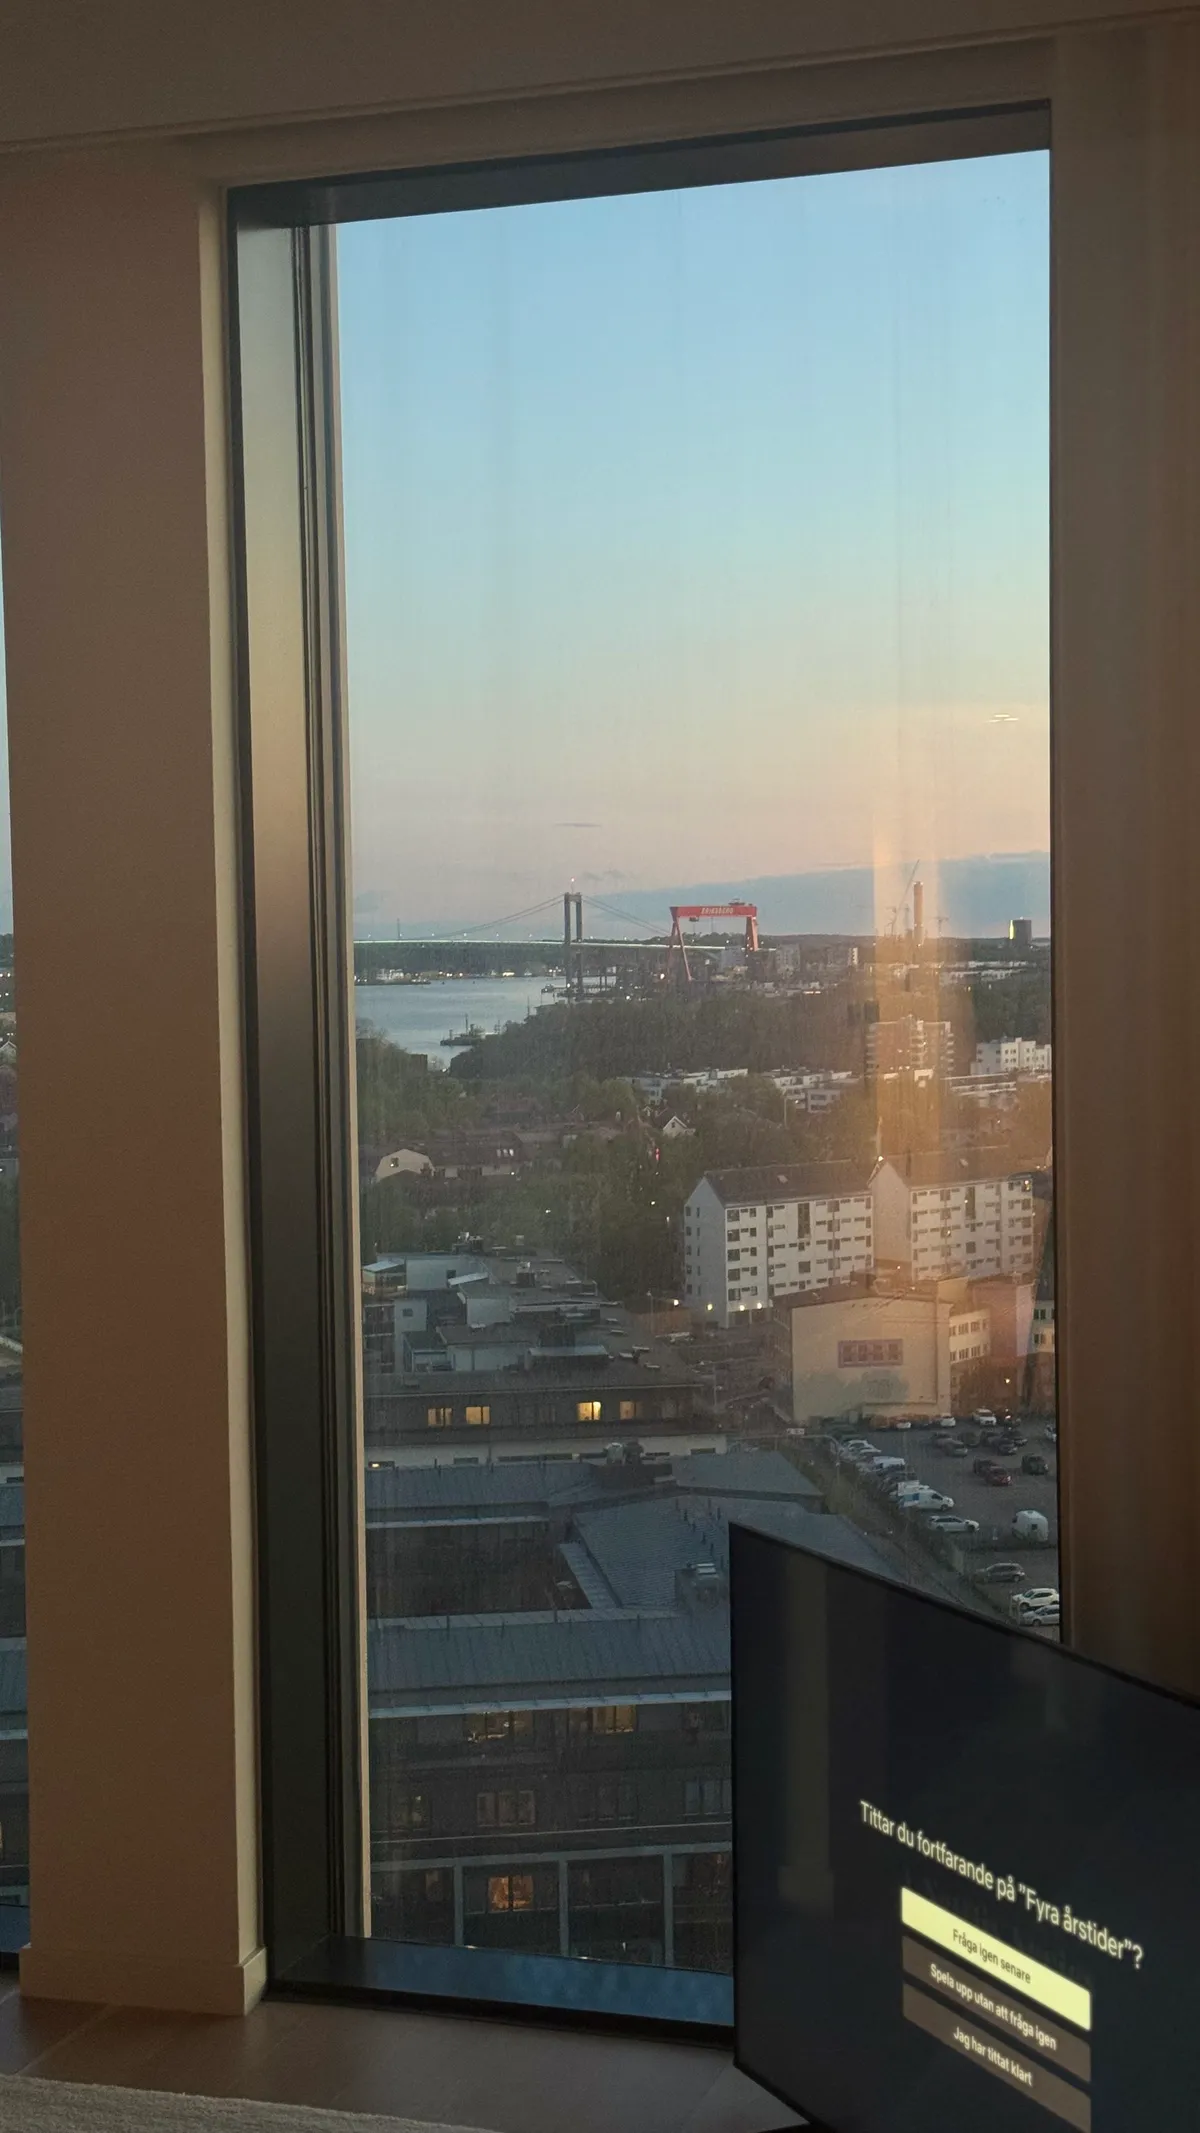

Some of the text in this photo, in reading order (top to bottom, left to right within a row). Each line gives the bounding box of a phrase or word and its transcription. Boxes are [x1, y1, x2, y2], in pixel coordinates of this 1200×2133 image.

[860, 1800, 895, 1836] Tittar
[897, 1822, 915, 1848] du
[917, 1830, 994, 1890] fortfarande
[996, 1874, 1016, 1902] på
[952, 1928, 1032, 1985] Fråga igen senare
[930, 1963, 1057, 2051] Spela upp utan att fråga igen
[953, 2027, 1033, 2087] Jag har tittat klart
